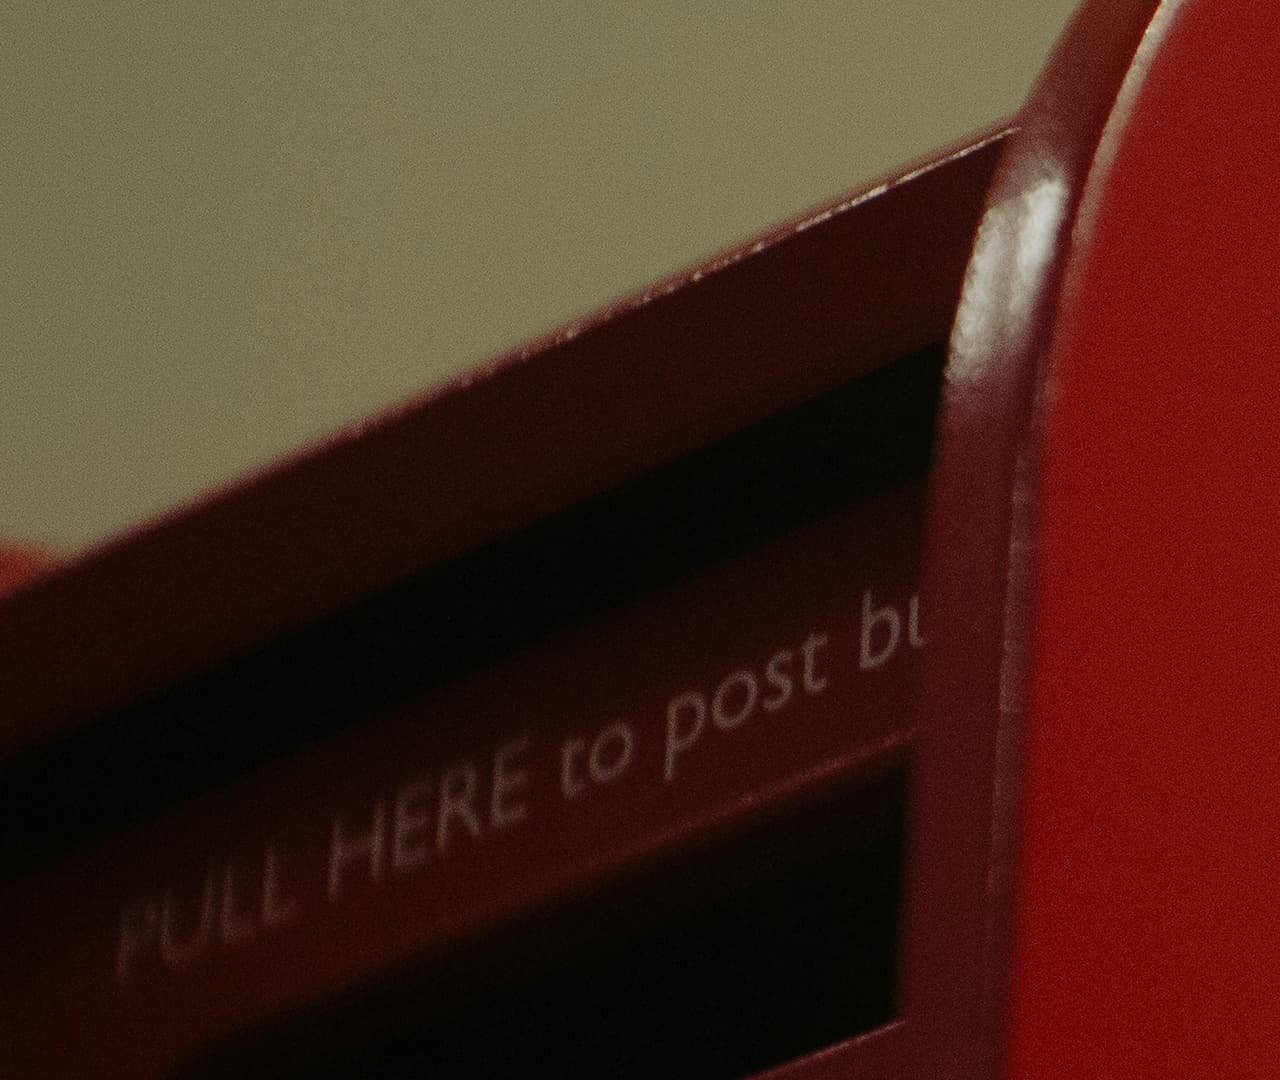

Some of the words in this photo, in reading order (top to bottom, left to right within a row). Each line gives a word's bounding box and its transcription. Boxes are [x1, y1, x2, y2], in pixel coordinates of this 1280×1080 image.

[114, 846, 300, 989] PULL
[325, 730, 529, 900] HERE
[561, 721, 633, 800] to
[663, 632, 829, 782] post
